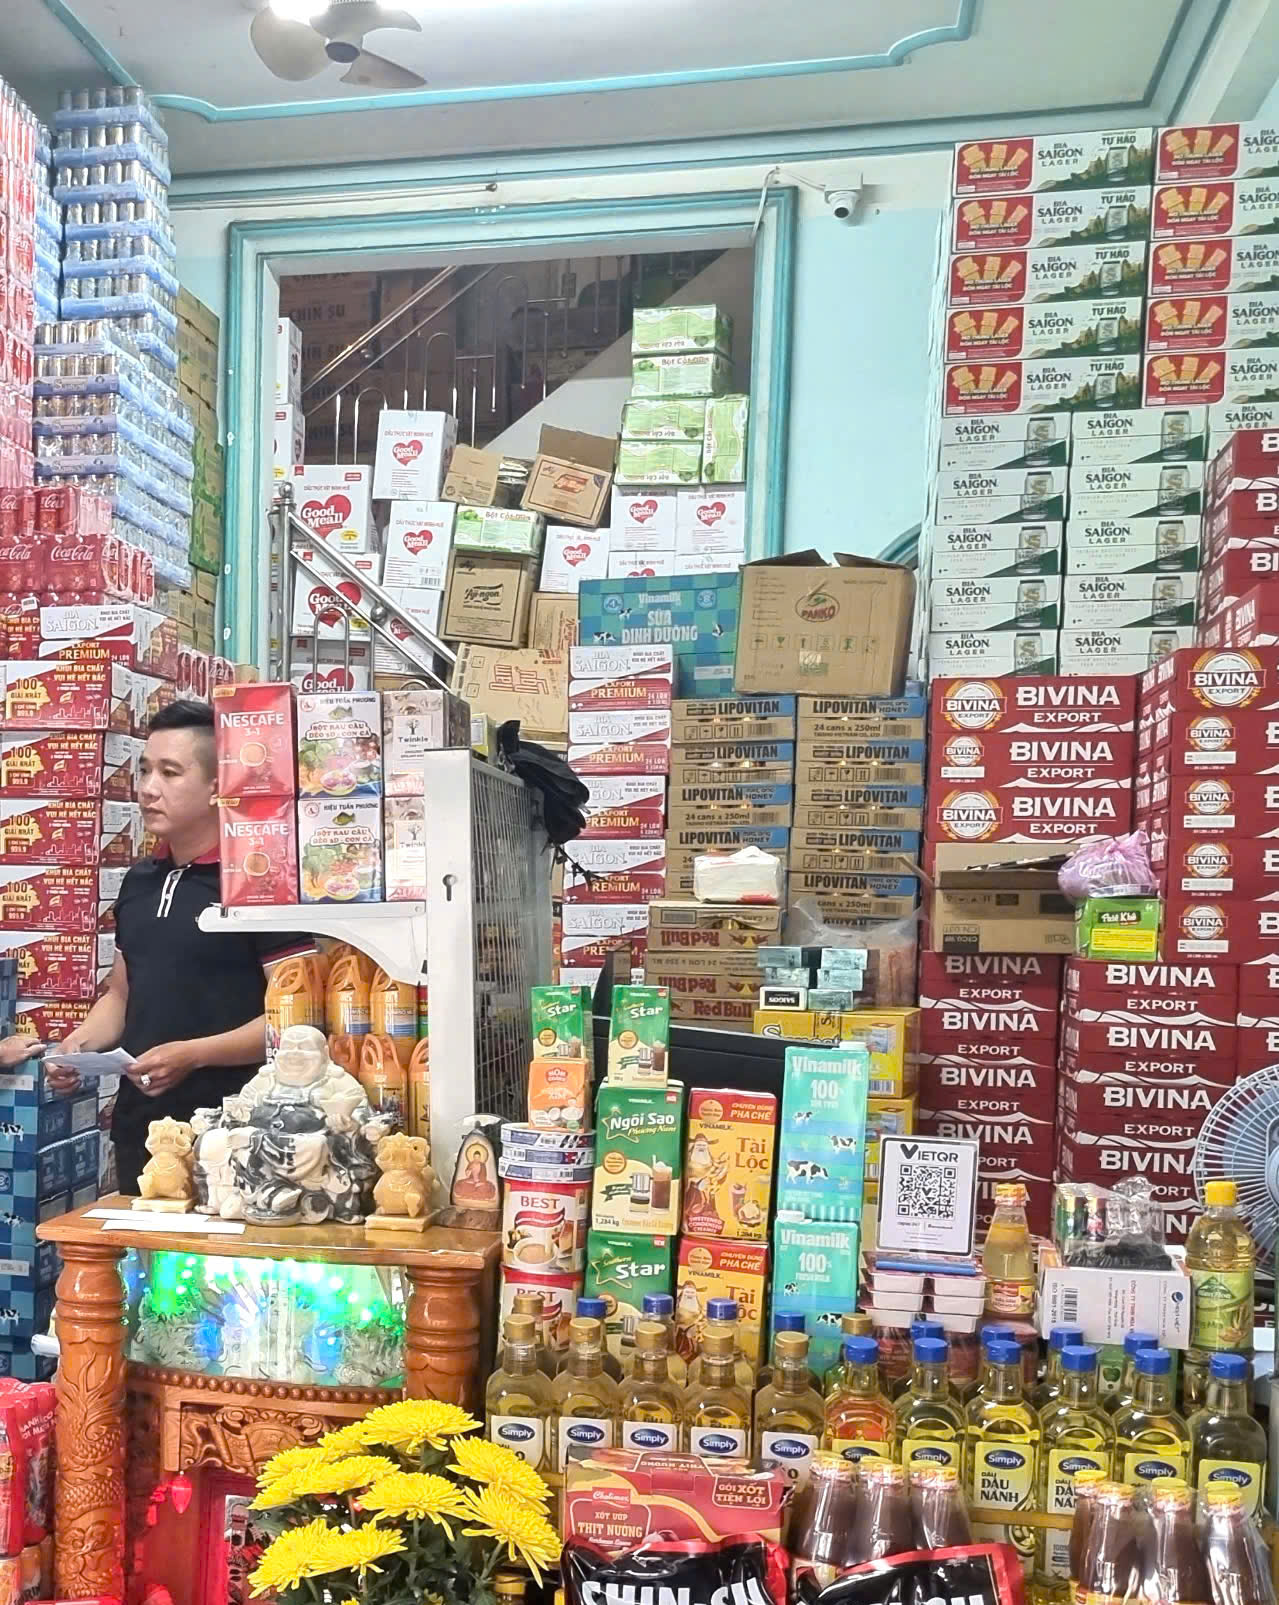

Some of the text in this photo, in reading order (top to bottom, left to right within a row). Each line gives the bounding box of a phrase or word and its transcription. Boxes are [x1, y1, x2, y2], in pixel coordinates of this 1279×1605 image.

[1037, 149, 1083, 161] SAIGON
[1037, 206, 1082, 217] SAIGON
[1041, 216, 1079, 224] LAGER
[1031, 262, 1077, 274] SAIGON
[1028, 318, 1073, 329] SAIGON
[1027, 372, 1071, 384] SAIGON
[1087, 417, 1133, 430] SAIGON
[954, 425, 1000, 436] SAIGON
[953, 479, 998, 490] SAIGON
[1085, 472, 1131, 484] SAIGON
[301, 501, 342, 519] Good
[947, 533, 992, 544] SAIGON
[1084, 527, 1131, 538] SAIGON
[59, 649, 110, 660] PREMIUM
[15, 679, 37, 689] 100
[1194, 673, 1258, 685] BIVINA
[591, 688, 646, 698] PREMIUM
[1016, 685, 1120, 706] BIVINA
[719, 701, 779, 714] LIPOVITAN
[813, 700, 876, 714] LIPOVITAN
[1033, 712, 1101, 722] EXPORT
[10, 747, 31, 758] 100
[717, 746, 778, 759] LIPOVITAN
[846, 744, 909, 759] LIPOVITAN
[1009, 741, 1113, 761] BIVINA
[1027, 768, 1095, 778] EXPORT
[682, 788, 743, 801] LIPOVITAN
[845, 789, 907, 803] LIPOVITAN
[1012, 797, 1116, 818] BIVINA
[8, 815, 30, 826] 100
[942, 809, 997, 822] BIVINA
[1030, 824, 1097, 834] EXPORT
[679, 831, 740, 845] LIPOVITAN
[839, 833, 902, 847] LIPOVITAN
[945, 955, 1041, 975] BIVINA
[1106, 964, 1215, 988] BIVINA
[959, 989, 1022, 999] EXPORT
[546, 1003, 576, 1017] Star
[694, 1001, 720, 1015] Red
[1126, 999, 1198, 1011] EXPORT
[630, 1005, 663, 1019] Star
[942, 1012, 1039, 1032] BIVINA
[1107, 1027, 1216, 1051] BIVINA
[957, 1045, 1020, 1055] EXPORT
[792, 1056, 862, 1075] Vinamilk
[1124, 1061, 1196, 1073] EXPORT
[940, 1067, 1036, 1087] BIVINA
[1104, 1087, 1212, 1109] BIVINA
[610, 1113, 675, 1131] Ngôi Sao
[737, 1137, 766, 1154] Tài
[900, 1144, 958, 1163] VIETQR
[735, 1152, 769, 1174] Lộc
[520, 1196, 560, 1209] BEST
[780, 1229, 850, 1249] Vinamilk
[616, 1262, 665, 1280] Star
[501, 1426, 533, 1439] Simply
[569, 1427, 602, 1441] Simply
[634, 1431, 666, 1445] Simply
[702, 1438, 736, 1451] Simply
[774, 1442, 807, 1457] Simply
[988, 1454, 1022, 1467] Simply
[1137, 1466, 1174, 1477] Simply
[1212, 1474, 1249, 1485] Simply
